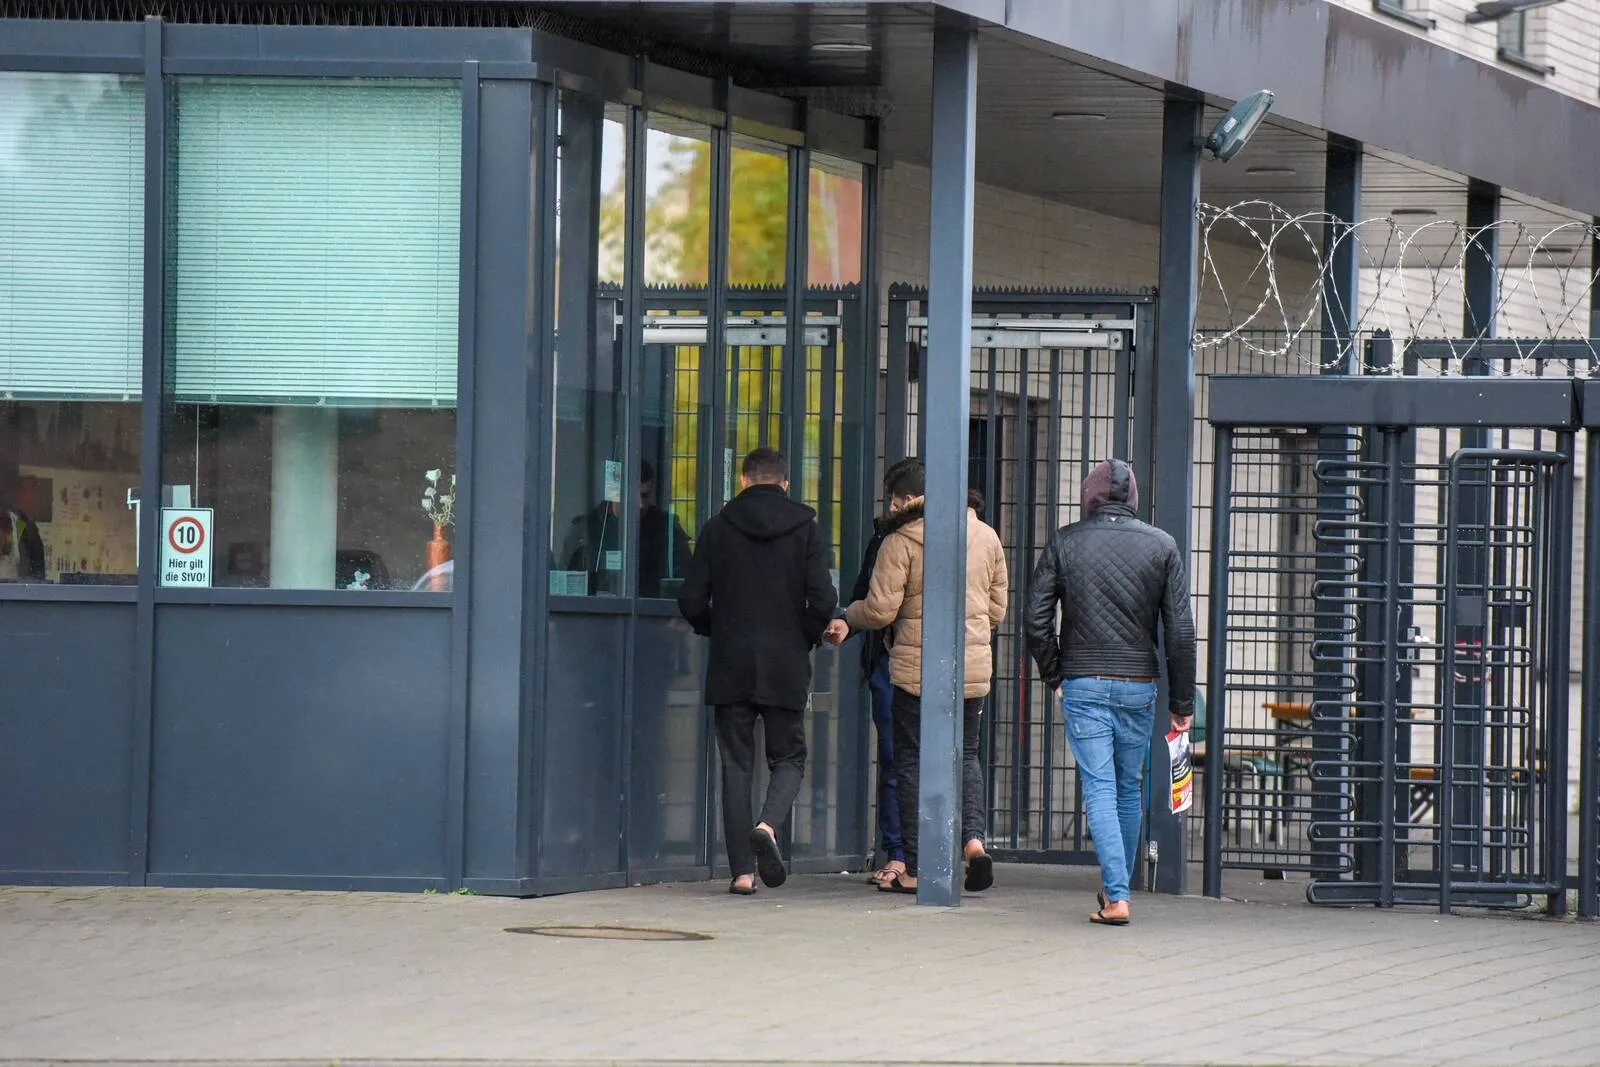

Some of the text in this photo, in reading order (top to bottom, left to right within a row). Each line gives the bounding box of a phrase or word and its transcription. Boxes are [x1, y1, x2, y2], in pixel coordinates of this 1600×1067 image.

[178, 526, 195, 544] 10
[169, 558, 203, 570] Hier gilt
[165, 572, 206, 582] die StVO!
